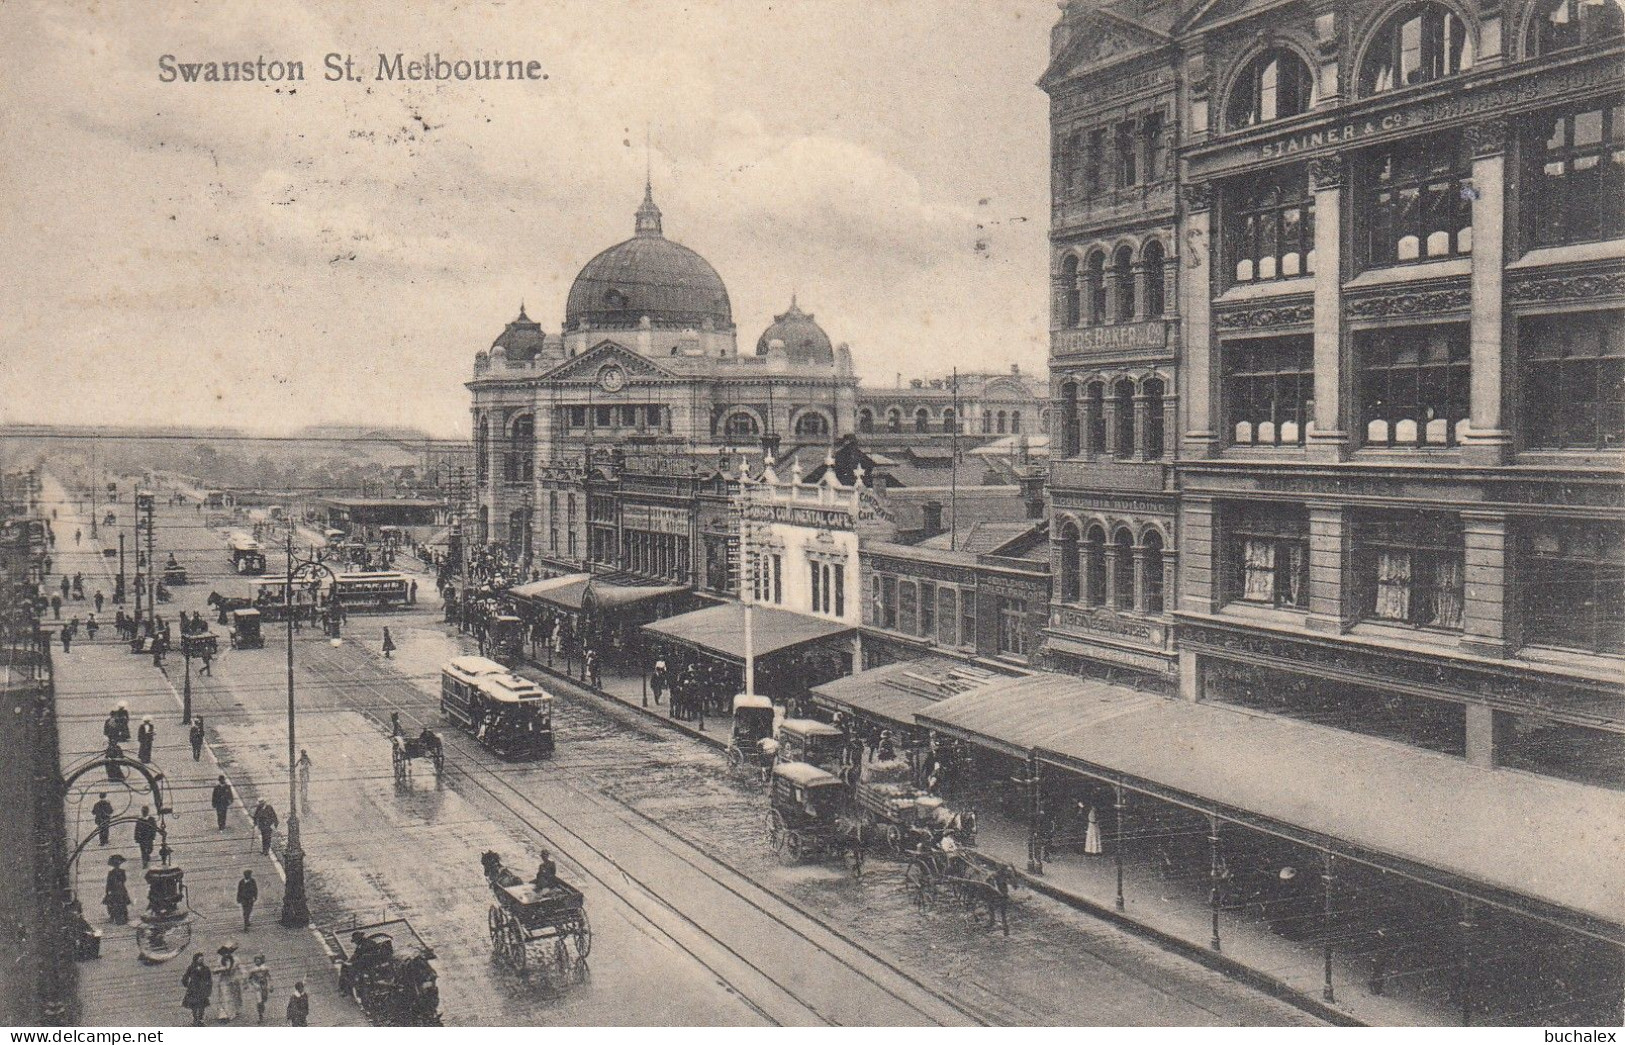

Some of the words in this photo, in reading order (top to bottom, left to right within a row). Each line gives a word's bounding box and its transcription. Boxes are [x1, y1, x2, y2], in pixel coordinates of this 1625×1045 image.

[1262, 124, 1354, 157] STAINER
[1364, 122, 1374, 135] &
[1094, 326, 1136, 349] BAKER
[1060, 497, 1112, 508] COLUMBIA
